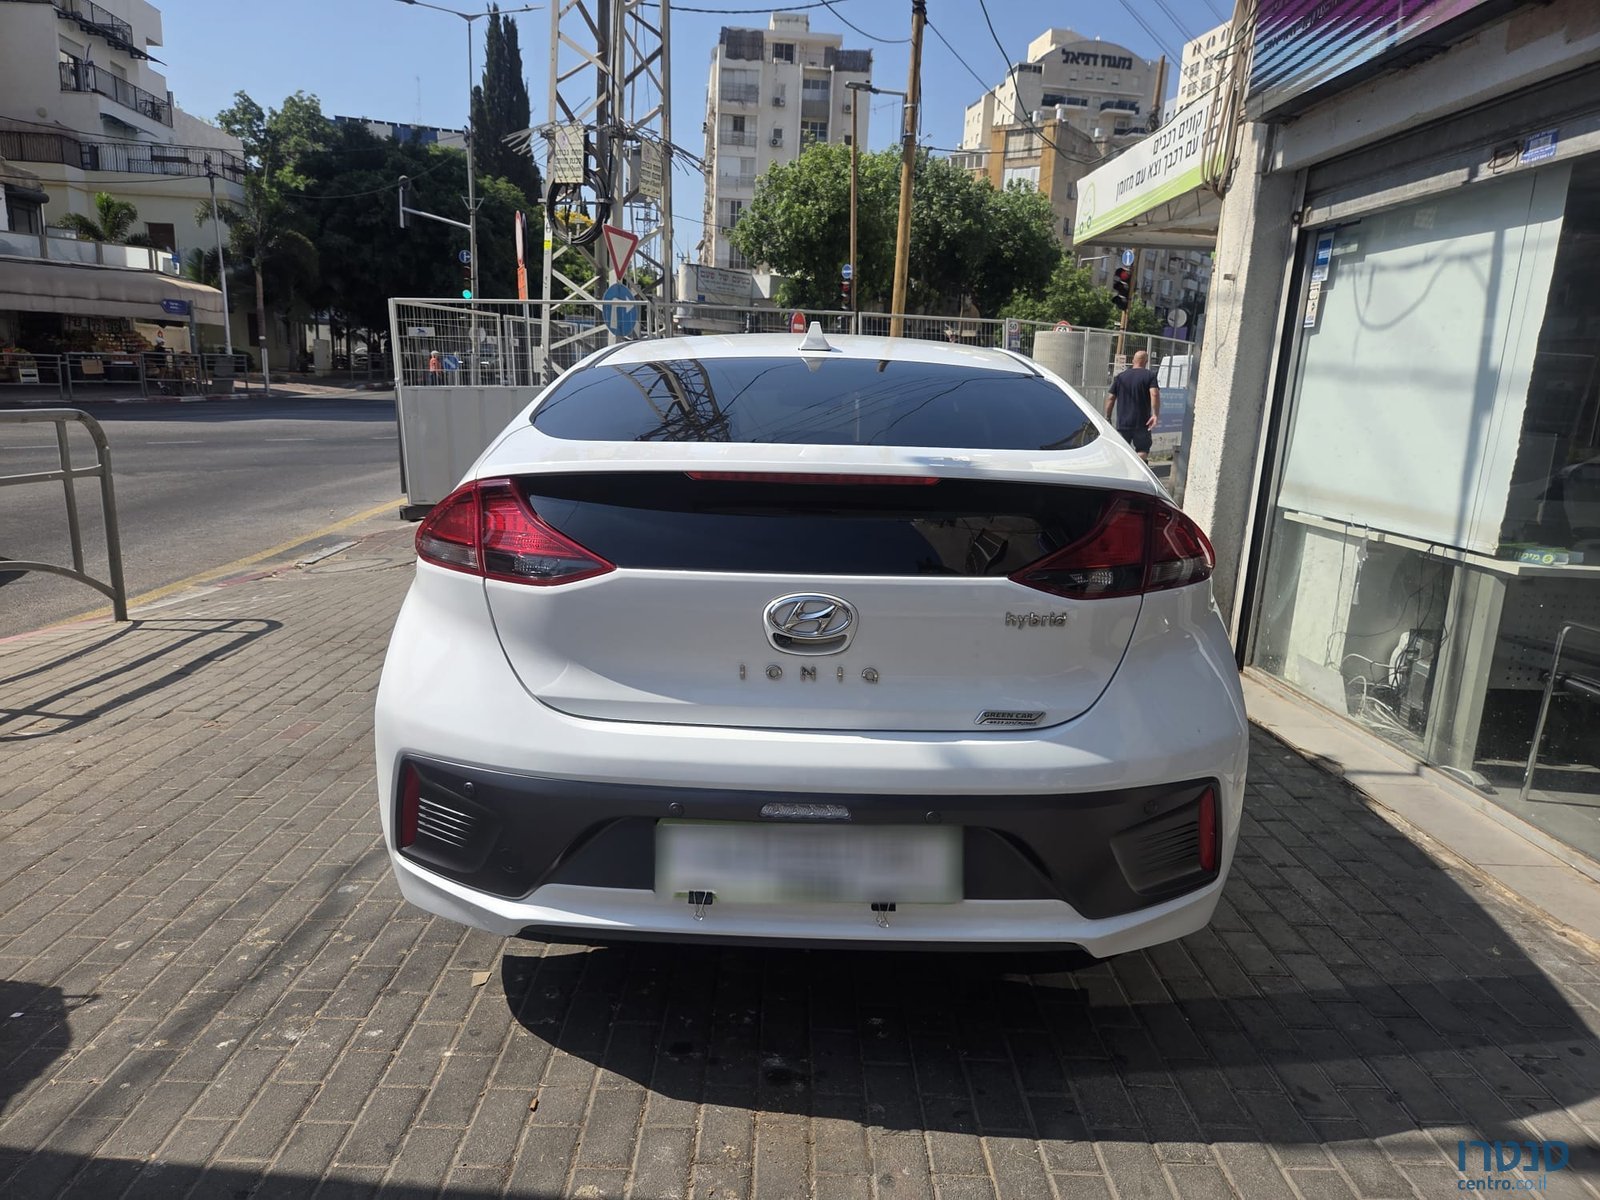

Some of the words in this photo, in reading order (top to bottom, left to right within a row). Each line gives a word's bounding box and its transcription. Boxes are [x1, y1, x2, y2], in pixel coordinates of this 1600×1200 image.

[1061, 48, 1099, 66] דניאל
[1101, 54, 1133, 70] מעוז
[1178, 109, 1203, 140] קונים
[1153, 128, 1176, 156] רכבים
[1185, 136, 1199, 159] עם
[1147, 159, 1161, 180] וצא
[1164, 145, 1183, 176] רכבך
[1136, 167, 1146, 187] עם
[1116, 175, 1134, 202] מזומן
[1005, 611, 1068, 630] hybrid
[739, 663, 879, 685] IONIQ
